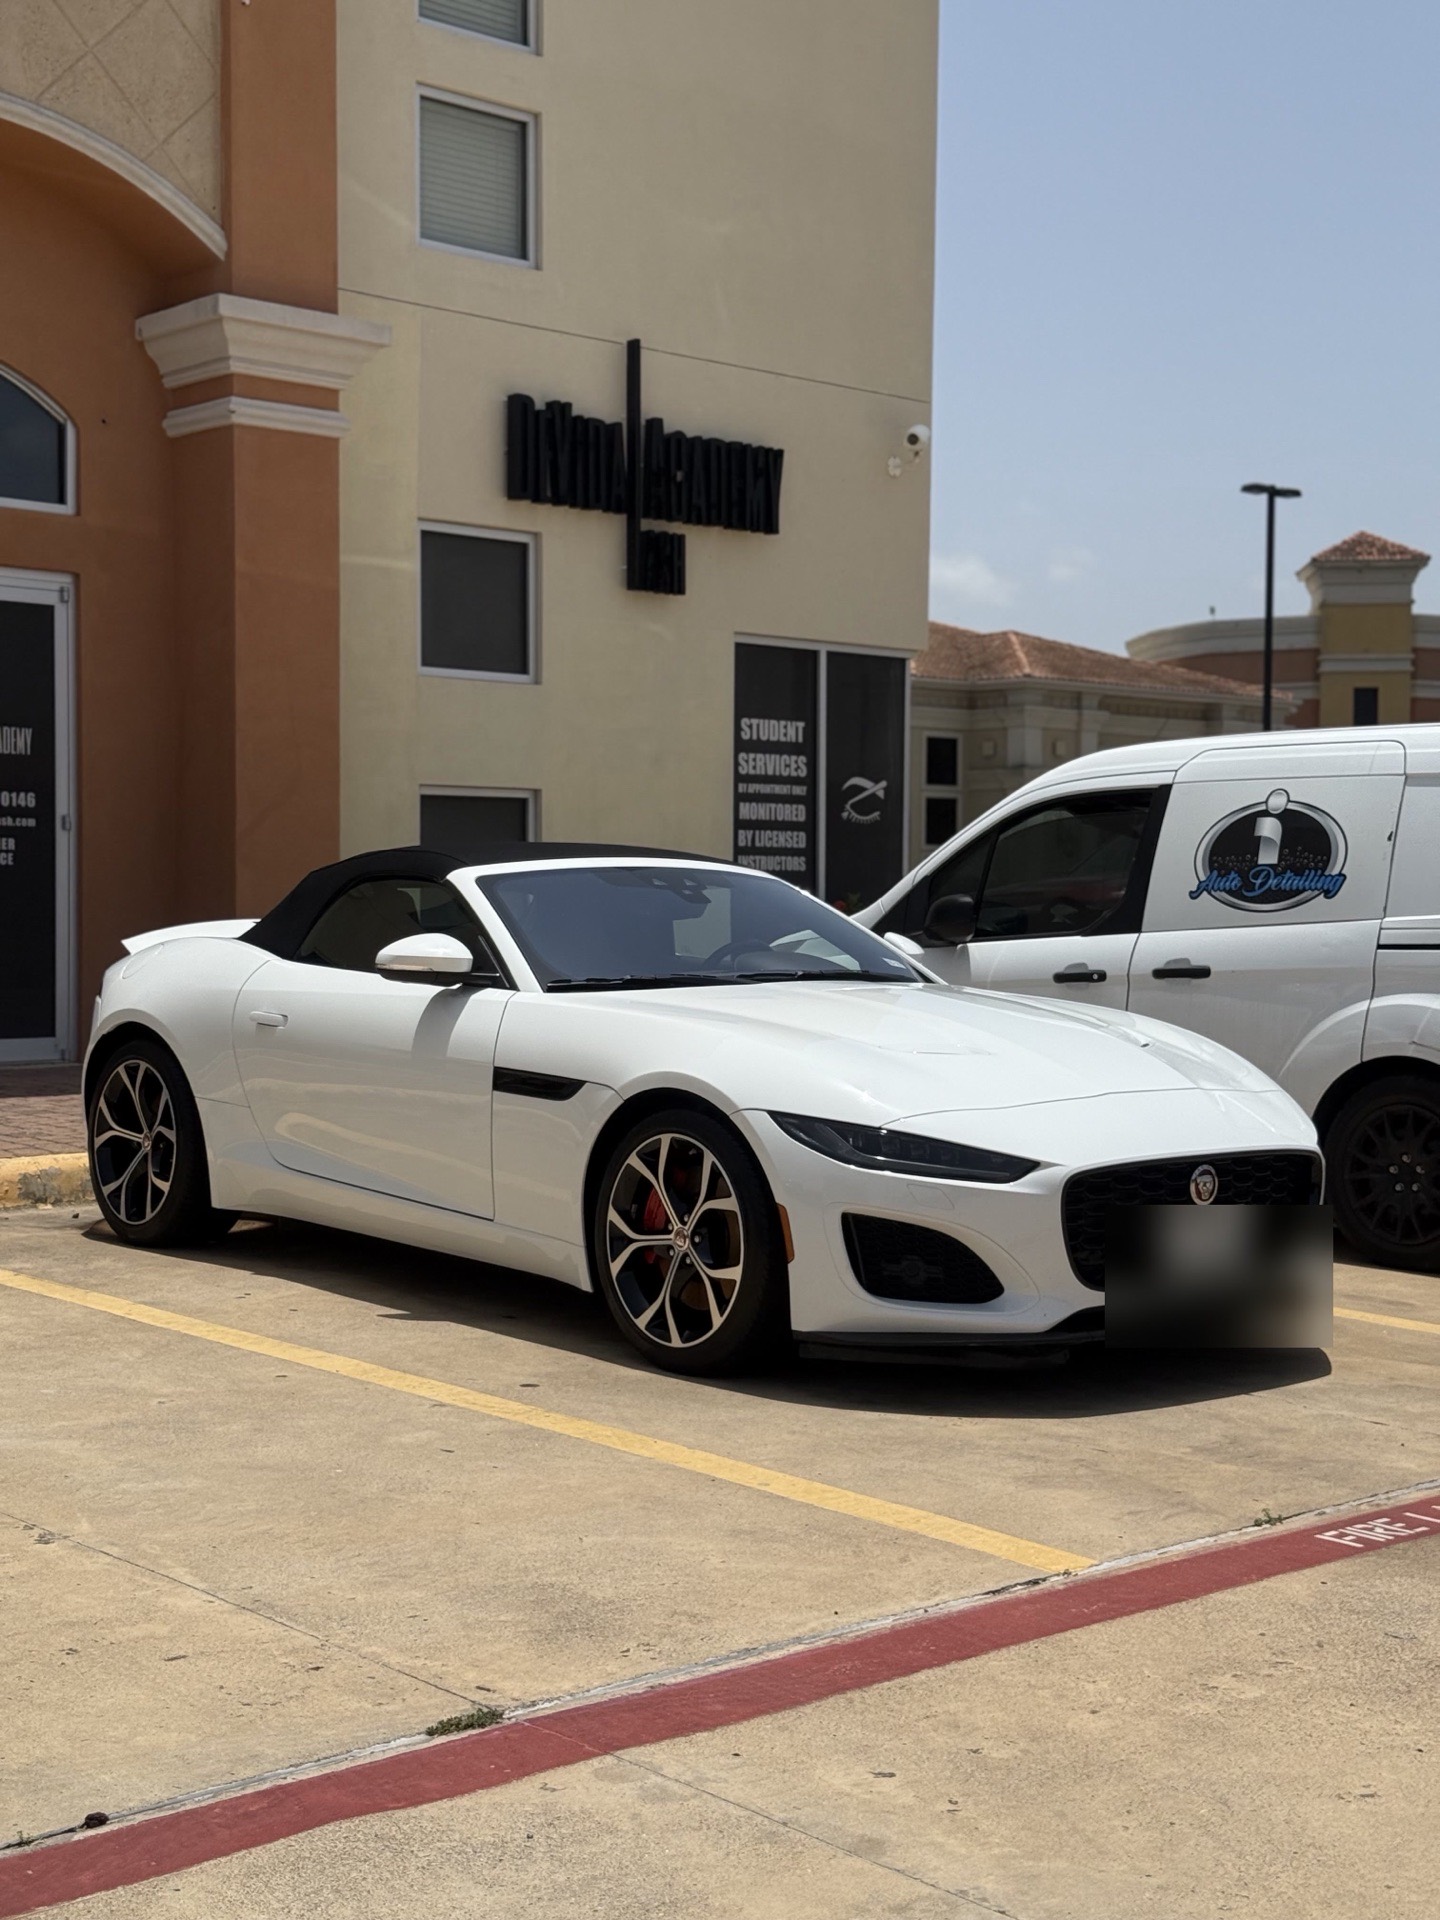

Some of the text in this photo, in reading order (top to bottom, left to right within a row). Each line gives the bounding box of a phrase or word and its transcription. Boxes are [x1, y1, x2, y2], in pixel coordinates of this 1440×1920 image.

[740, 717, 806, 743] STUDENT
[738, 752, 808, 778] SERVICES
[0, 815, 36, 828] sh.com
[739, 801, 806, 822] MONITORED
[738, 829, 806, 849] BY LICENSED
[738, 855, 806, 872] INSTRUCTORS
[1189, 865, 1346, 899] Auto Detailing
[1313, 1517, 1431, 1548] FIRE
